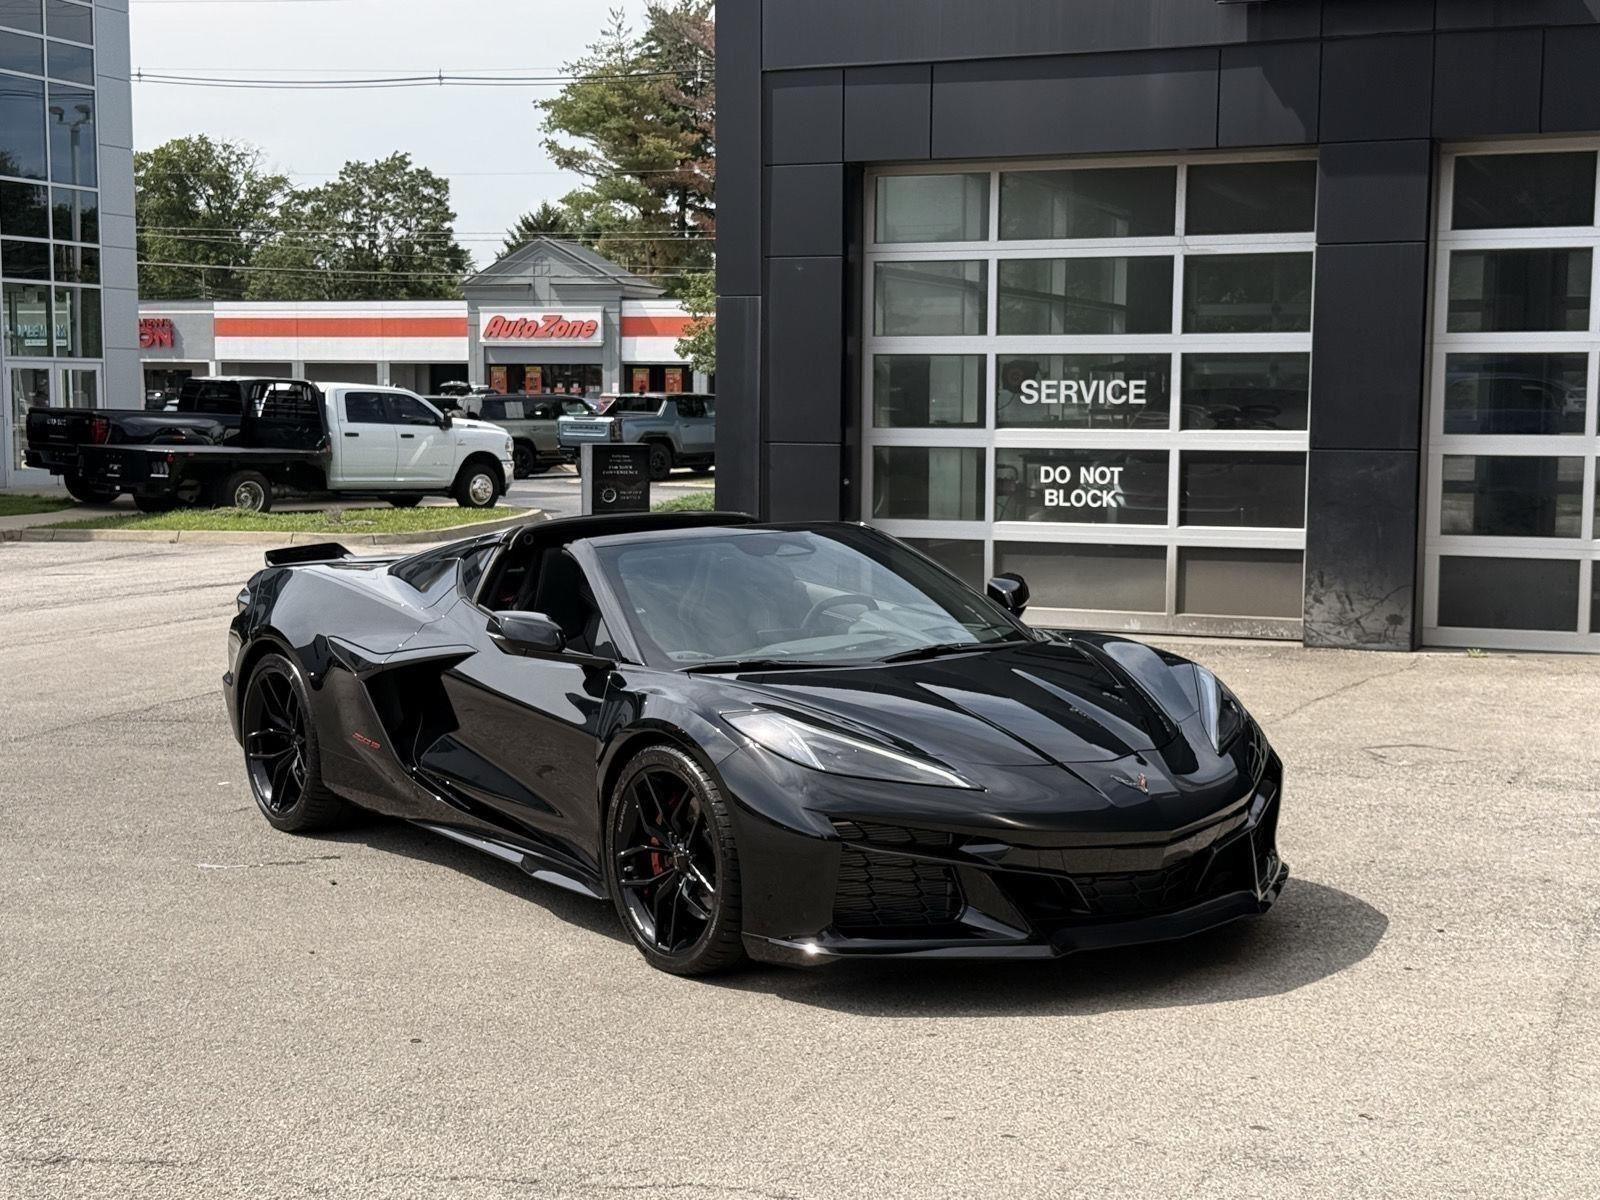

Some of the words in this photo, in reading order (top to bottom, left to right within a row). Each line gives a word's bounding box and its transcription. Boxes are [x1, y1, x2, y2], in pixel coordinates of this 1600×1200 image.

[483, 315, 599, 339] AutoZone
[1020, 380, 1147, 404] SERVICE
[1040, 466, 1071, 484] DO
[1080, 466, 1123, 484] NOT
[1044, 489, 1117, 507] BLOCK
